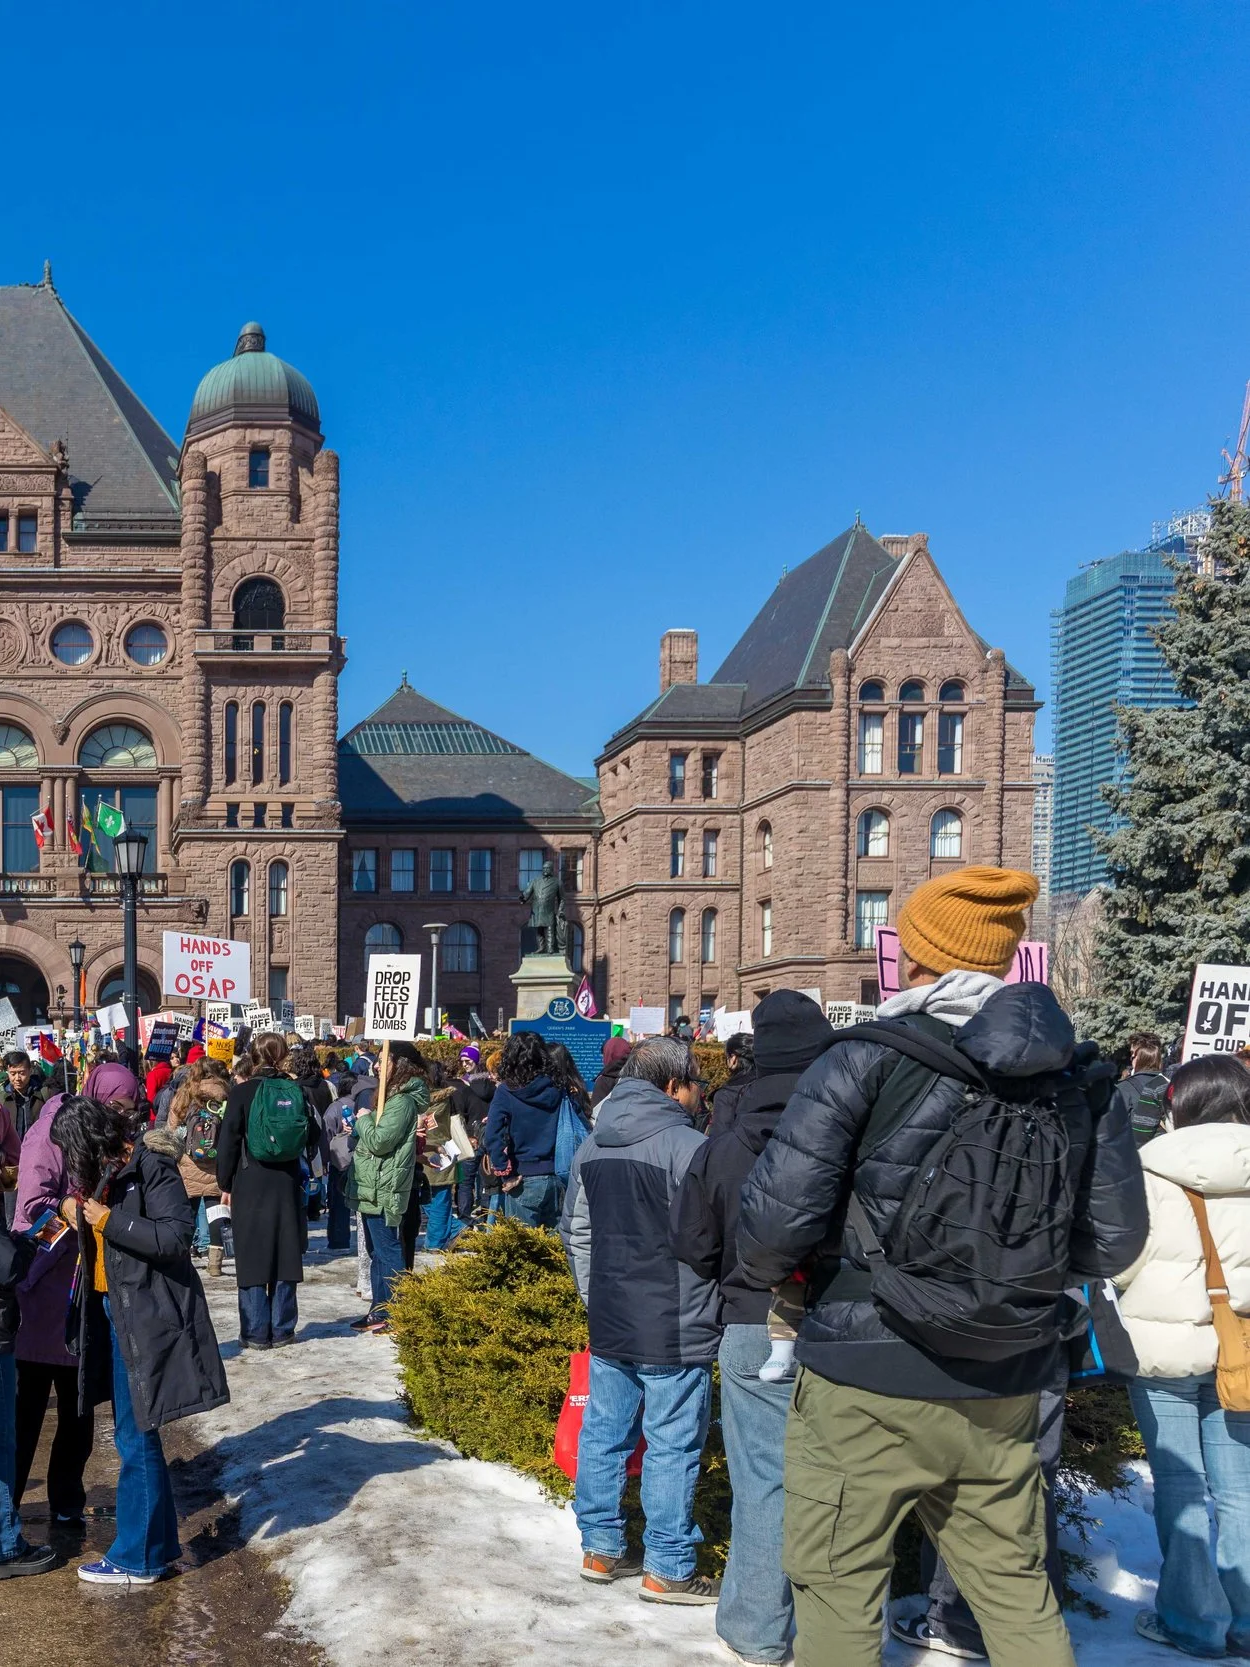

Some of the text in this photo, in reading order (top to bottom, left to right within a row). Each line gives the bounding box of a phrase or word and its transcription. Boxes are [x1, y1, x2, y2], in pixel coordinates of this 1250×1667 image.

[180, 936, 232, 956] HANDS
[190, 959, 214, 973] OFF
[375, 971, 411, 985] DROP
[174, 973, 236, 999] OSAP
[1199, 981, 1250, 1001] HAN
[374, 986, 410, 1002] FEES
[210, 1013, 228, 1022] OFF
[373, 1002, 409, 1020] NOT
[829, 1013, 851, 1023] OFF
[174, 1016, 194, 1026] HANDS
[251, 1018, 270, 1028] OFF
[372, 1020, 407, 1030] BOMBS
[1194, 1001, 1250, 1037] OF
[180, 1024, 192, 1035] FF
[148, 1044, 173, 1053] UNITED
[1214, 1038, 1246, 1052] OUR
